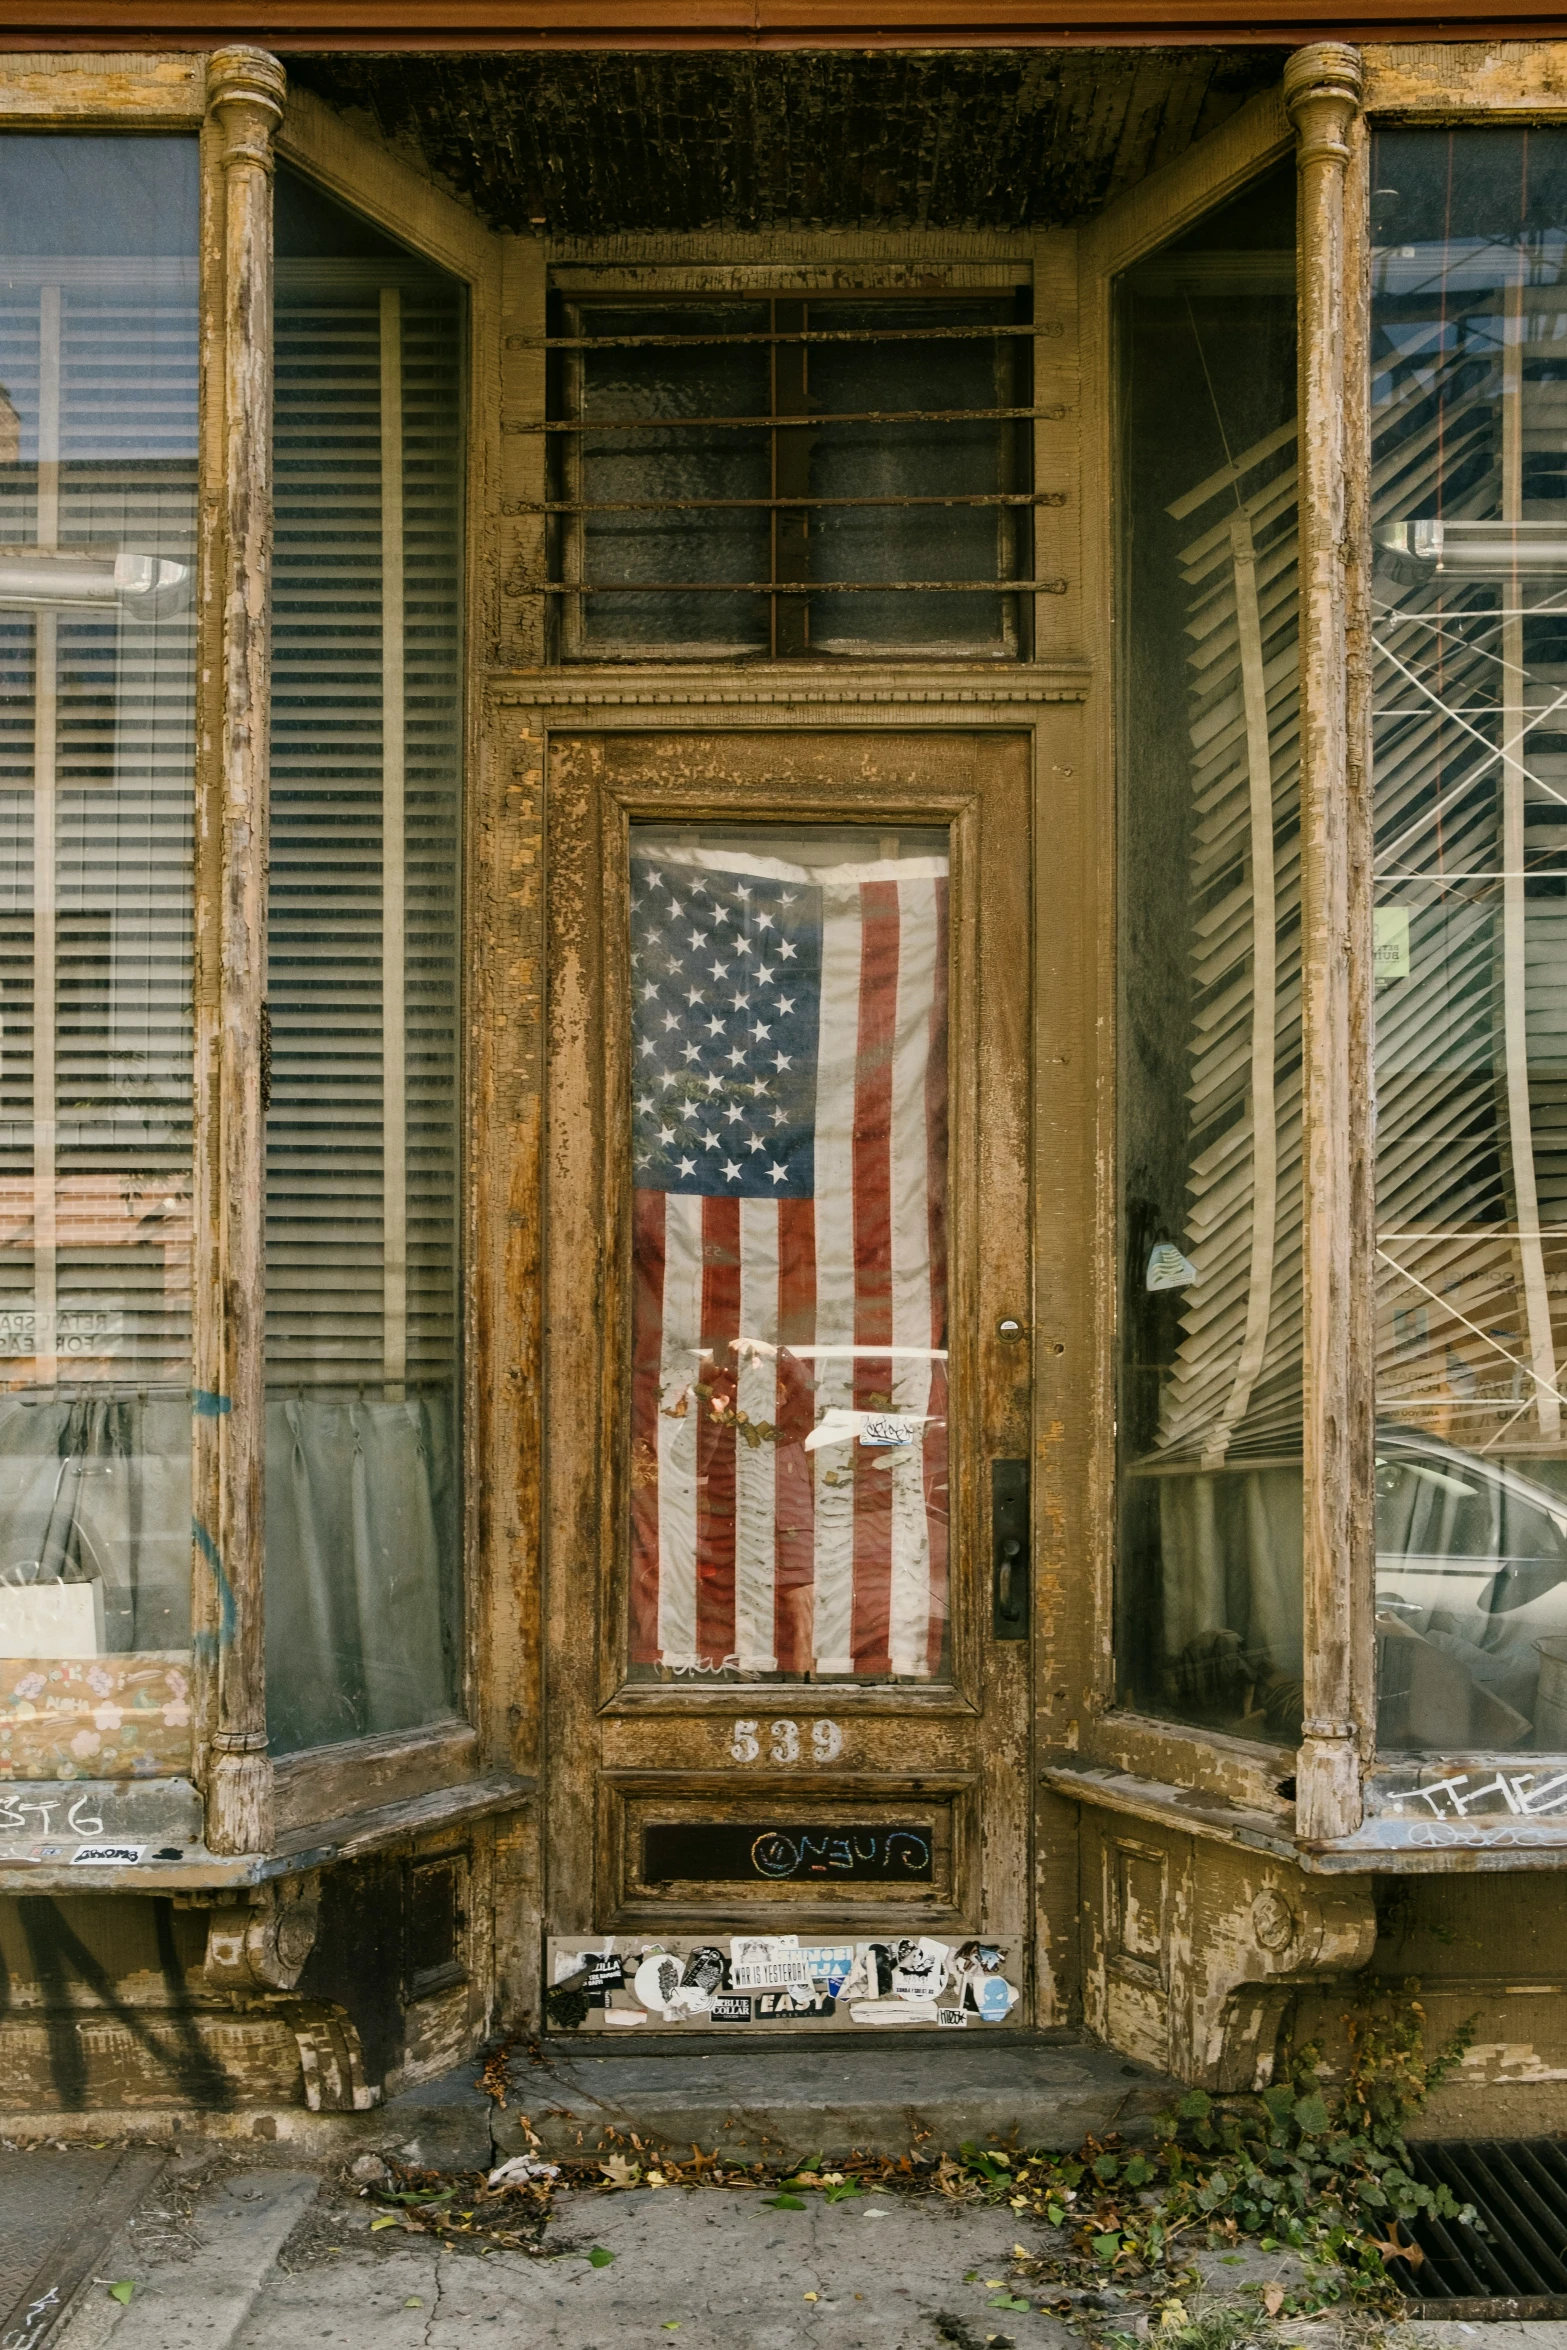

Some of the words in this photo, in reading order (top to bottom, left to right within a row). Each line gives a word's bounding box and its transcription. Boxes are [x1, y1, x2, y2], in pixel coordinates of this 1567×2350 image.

[730, 1718, 843, 1763] 539
[734, 1967, 751, 1986] WAR
[753, 1965, 761, 1984] IS
[763, 1962, 807, 1984] YESTERDAY
[713, 2006, 750, 2015] COLLAR
[724, 1999, 750, 2007] BLUE
